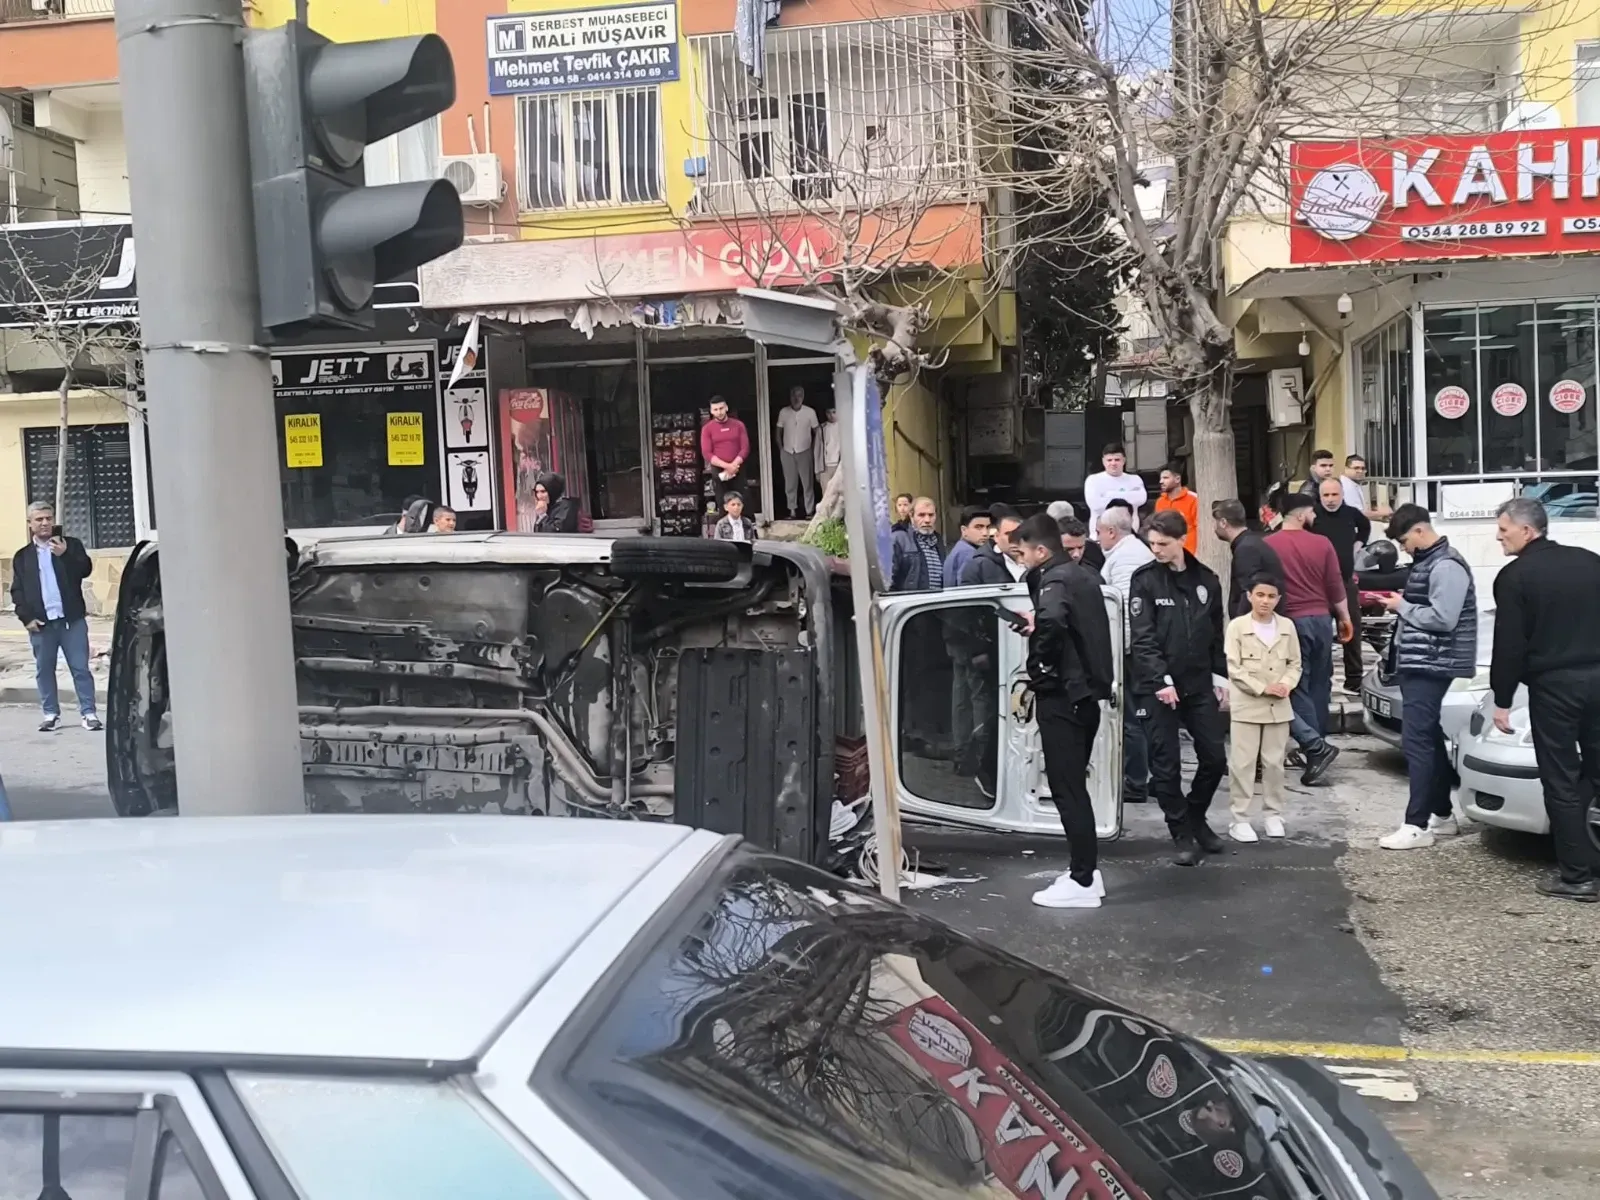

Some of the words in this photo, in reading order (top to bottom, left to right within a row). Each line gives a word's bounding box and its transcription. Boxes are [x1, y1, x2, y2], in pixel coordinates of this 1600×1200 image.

[530, 17, 585, 32] SERBEST
[588, 7, 668, 27] MUHASEBECİ
[494, 56, 560, 77] Mehmet
[563, 51, 613, 73] Tevfik
[617, 46, 671, 71] ÇAKIR
[506, 78, 530, 88] 0544
[587, 71, 612, 82] 0414
[613, 69, 632, 80] 314
[1408, 226, 1452, 239] 0544
[1458, 224, 1488, 236] 288
[1494, 222, 1514, 234] 89
[1520, 221, 1540, 233] 92
[1573, 218, 1600, 230] 05
[719, 236, 821, 277] GIDA
[76, 304, 139, 318] ELEKTRİKL
[300, 357, 370, 384] JETT
